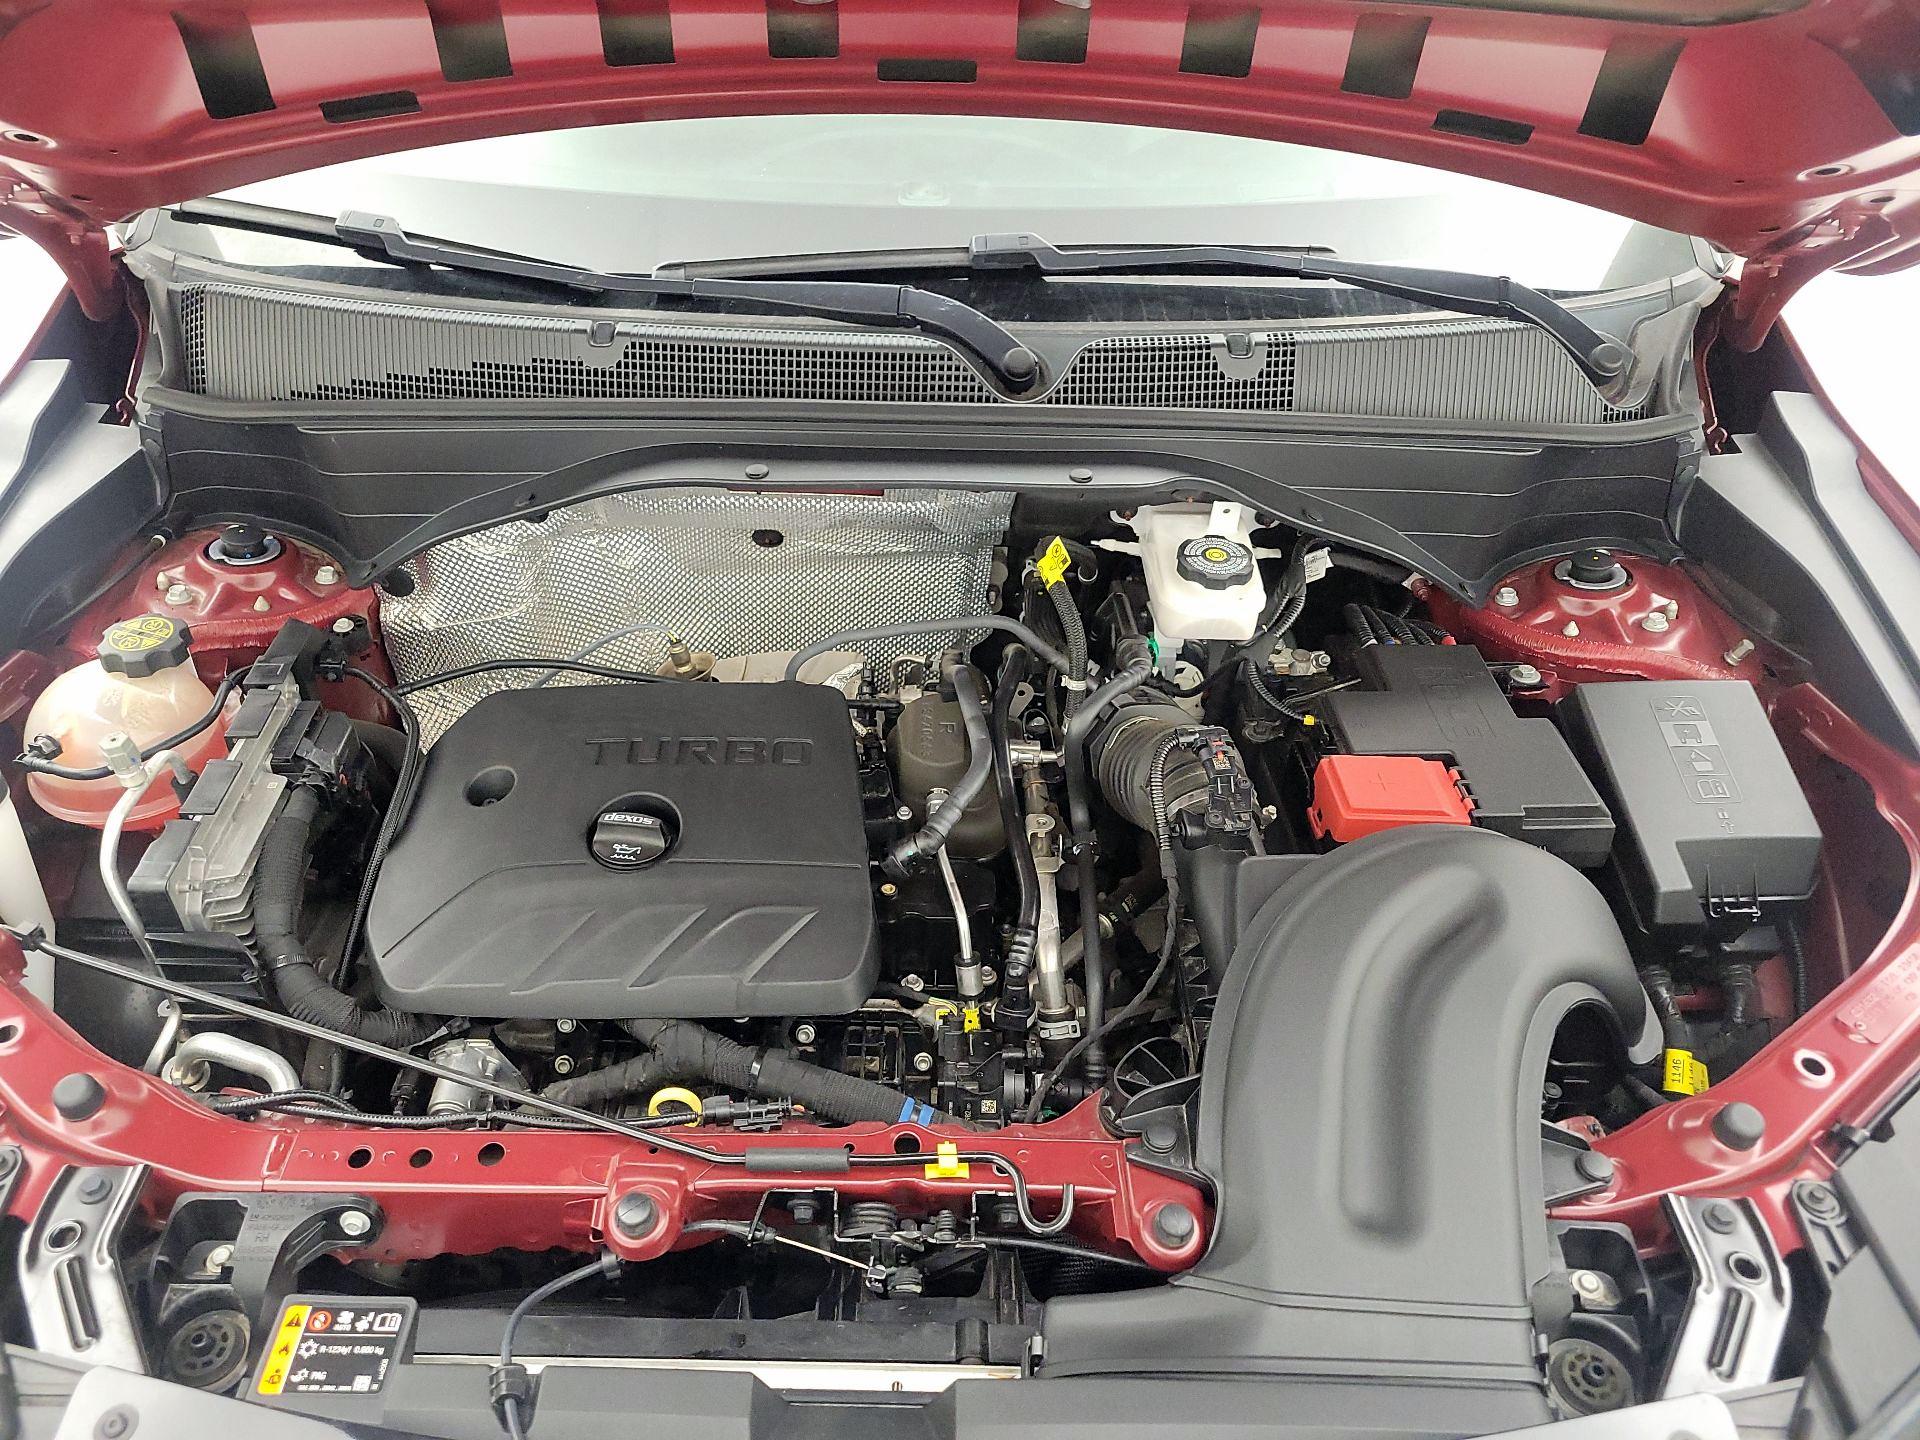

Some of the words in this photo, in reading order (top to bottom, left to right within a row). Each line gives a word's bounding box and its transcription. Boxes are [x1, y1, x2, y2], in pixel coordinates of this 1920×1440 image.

[585, 737, 814, 765] TURBO
[604, 812, 654, 825] dexos
[671, 1058, 682, 1084] 1146
